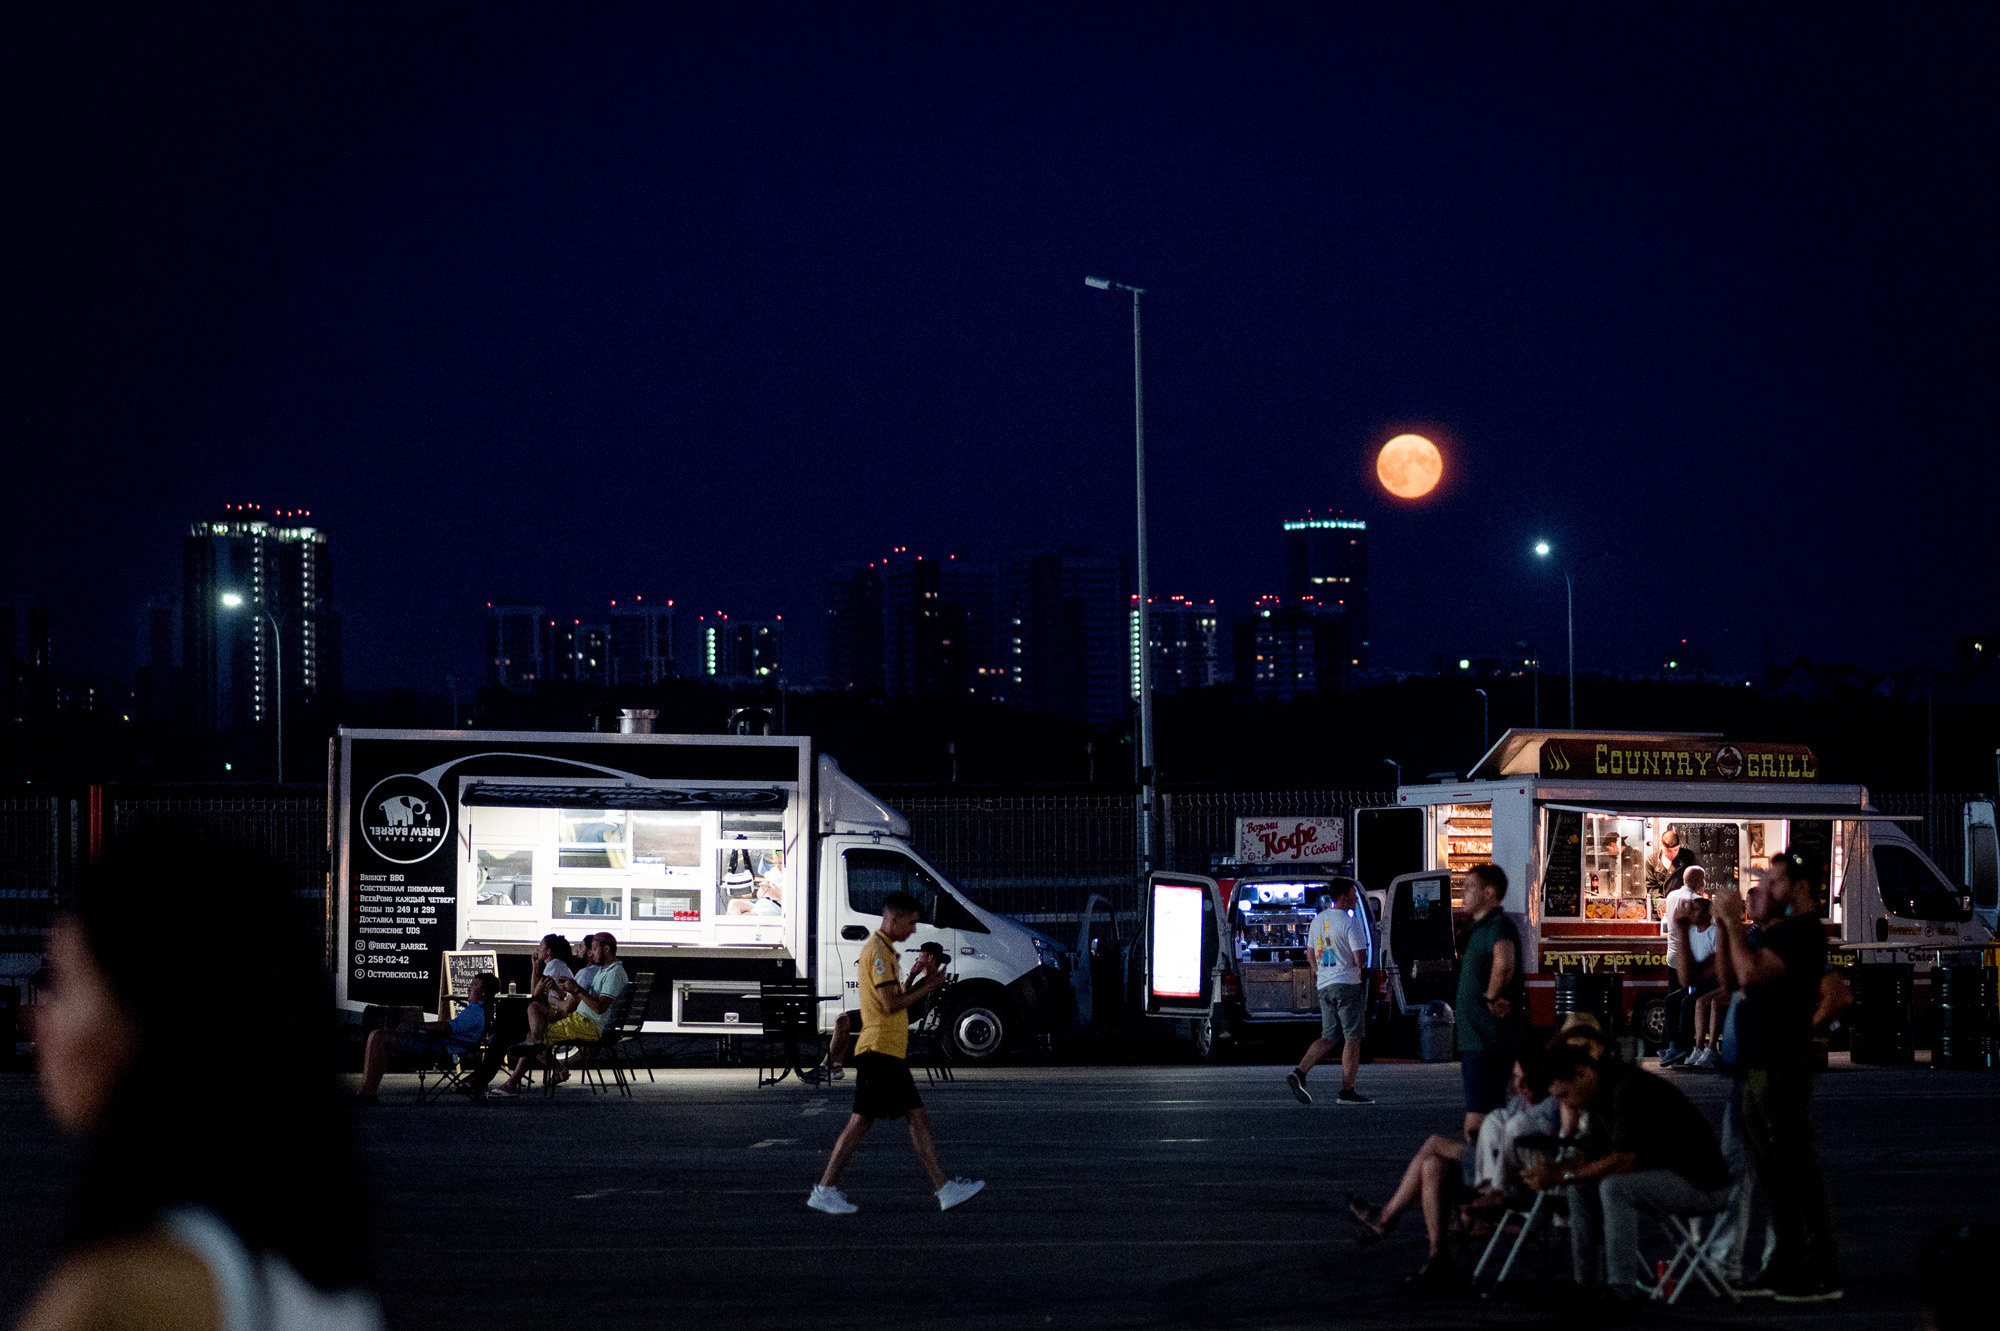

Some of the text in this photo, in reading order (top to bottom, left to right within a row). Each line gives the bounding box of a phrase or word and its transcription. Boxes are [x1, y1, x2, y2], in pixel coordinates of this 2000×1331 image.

[1595, 743, 1817, 778] COUNTRY GRILL
[369, 826, 441, 837] BREW BARREL
[1246, 821, 1278, 837] Возьми
[1258, 822, 1318, 860] Кофе
[389, 874, 405, 882] BBQ
[396, 905, 411, 914] 249
[421, 906, 436, 914] 299
[405, 926, 421, 935] UDS
